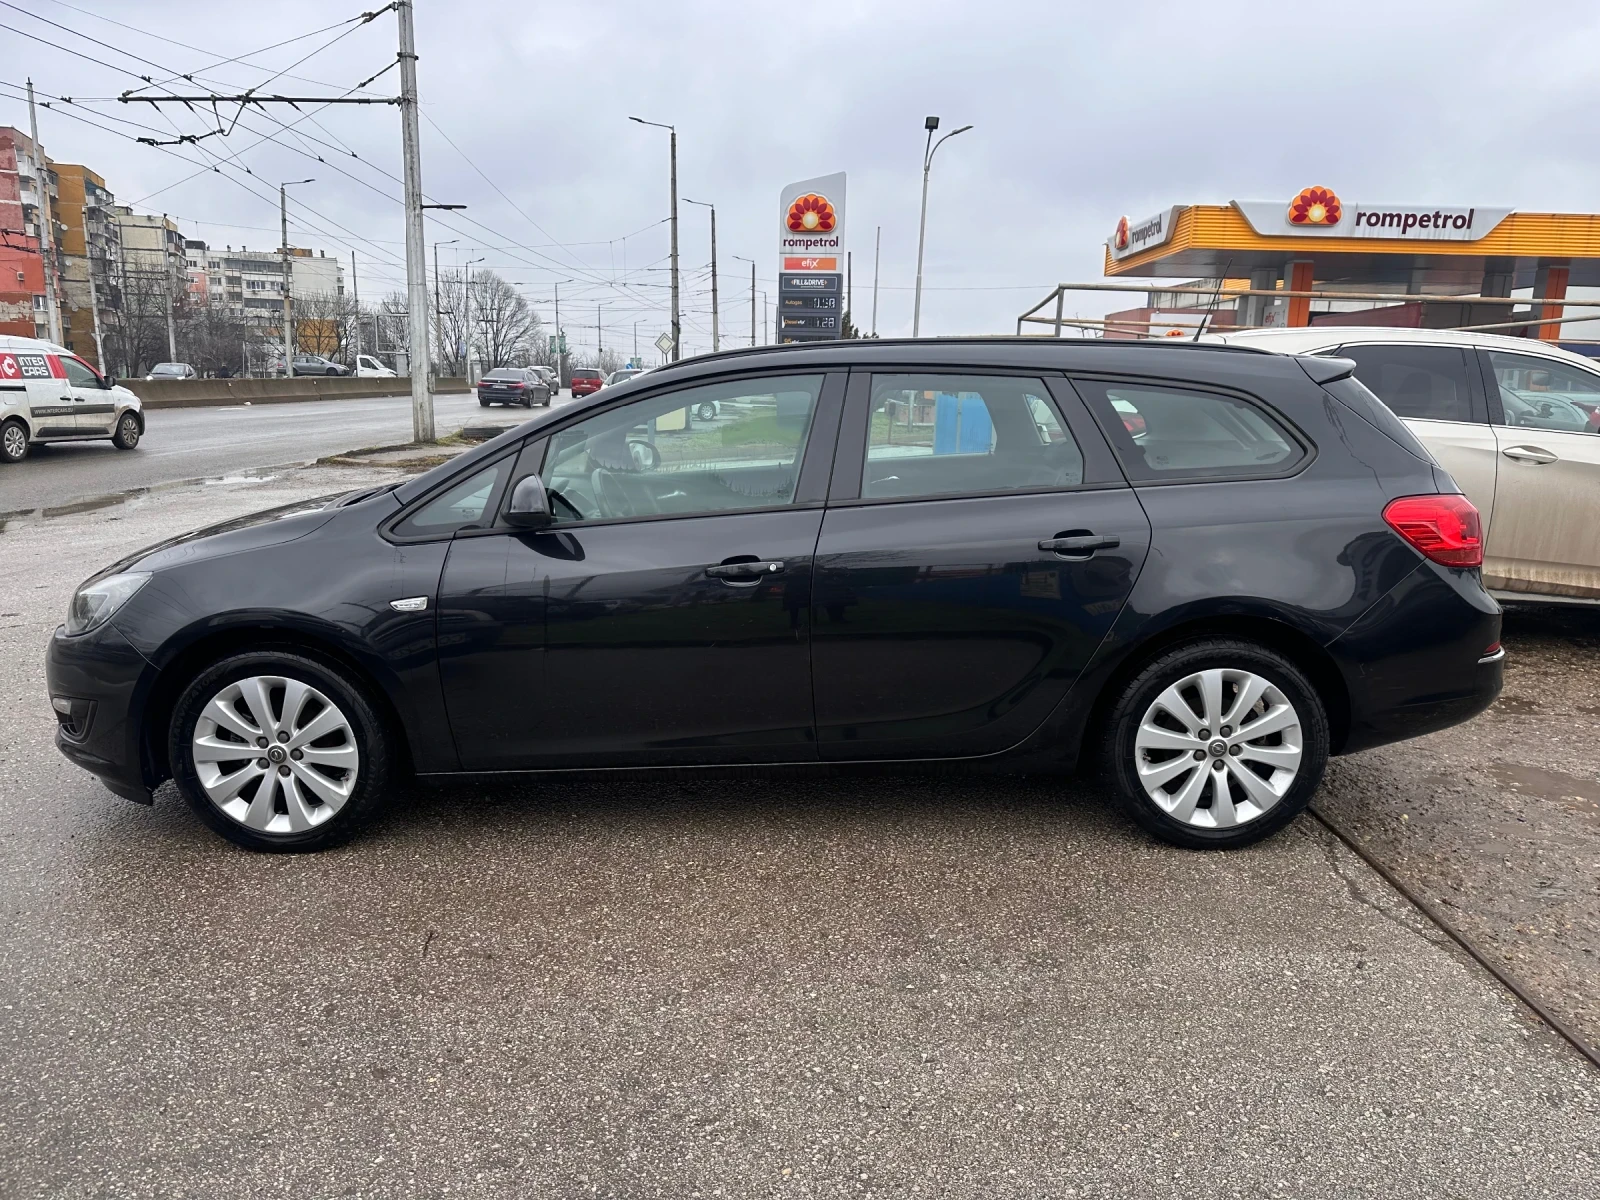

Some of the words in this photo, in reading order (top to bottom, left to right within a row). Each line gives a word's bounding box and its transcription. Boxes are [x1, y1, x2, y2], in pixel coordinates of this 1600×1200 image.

[1355, 208, 1475, 235] rompetrol
[1131, 213, 1162, 246] rompetrol
[783, 235, 839, 250] rompetrol
[801, 258, 820, 269] efix
[17, 356, 45, 366] INTER
[21, 366, 49, 376] CARS
